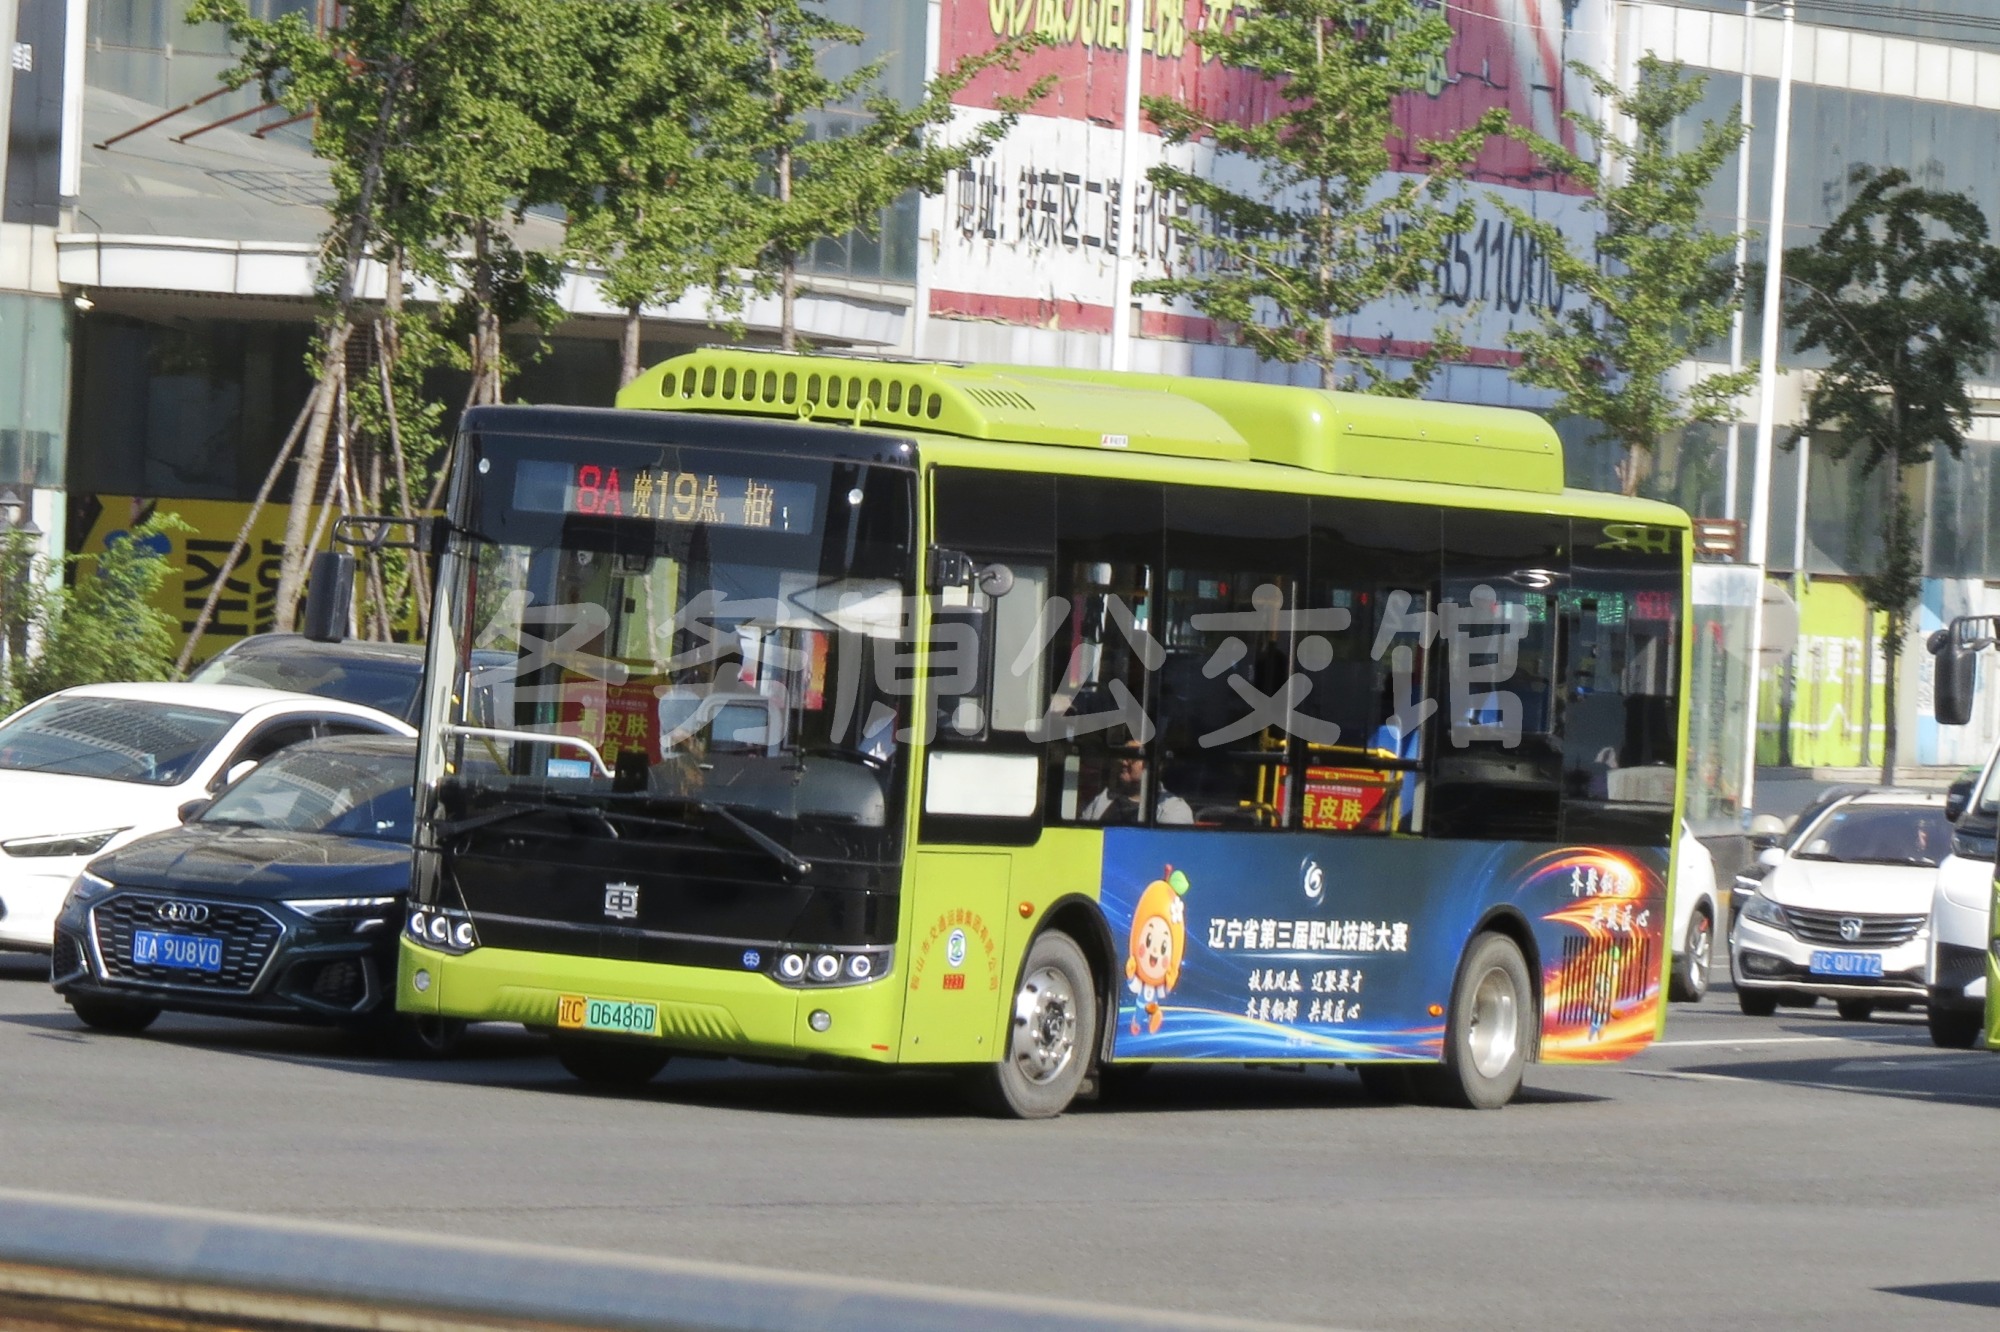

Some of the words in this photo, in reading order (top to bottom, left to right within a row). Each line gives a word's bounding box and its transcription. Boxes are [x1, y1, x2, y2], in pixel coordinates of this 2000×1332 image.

[577, 464, 623, 516] 8A
[1208, 918, 1409, 952] 辽宁省第三届职业技能大赛
